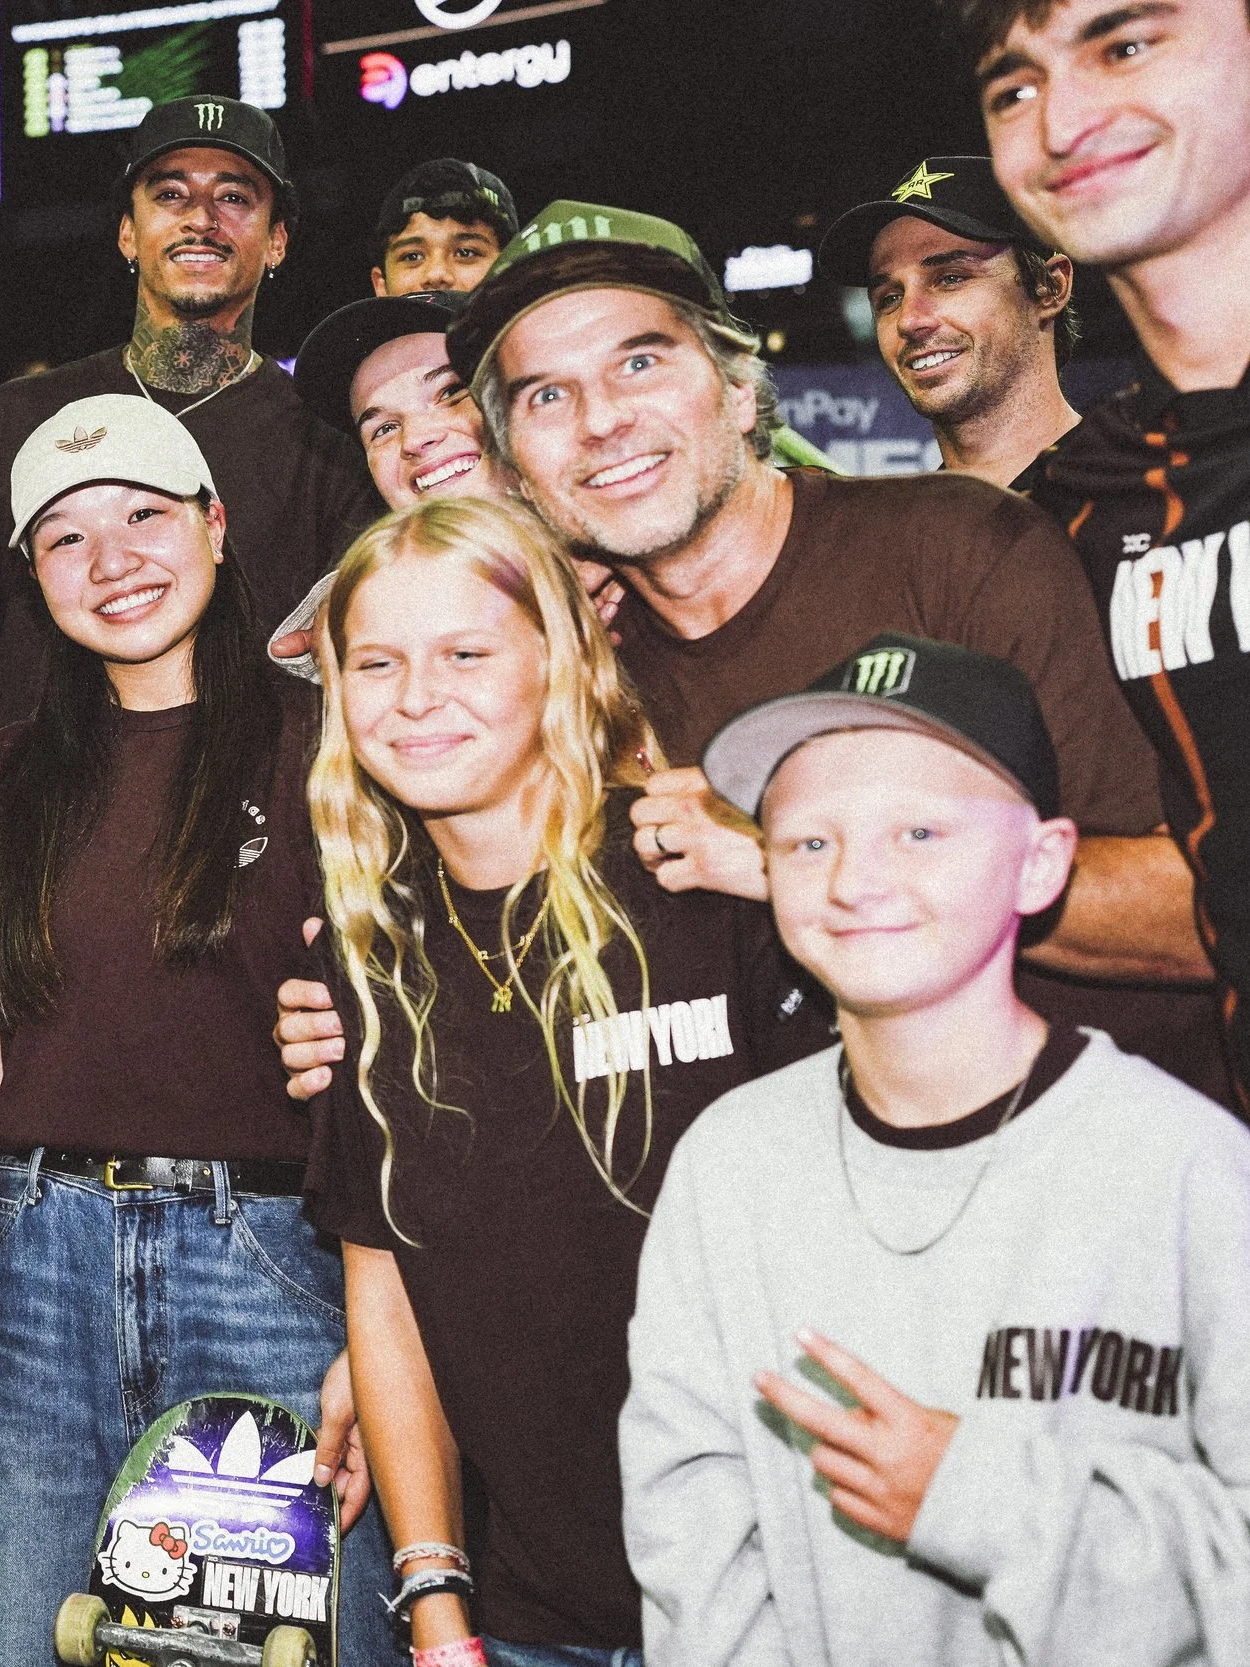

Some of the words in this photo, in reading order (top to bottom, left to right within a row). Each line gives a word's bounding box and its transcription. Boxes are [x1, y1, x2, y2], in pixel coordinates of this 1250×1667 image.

[774, 388, 881, 433] nPay
[1110, 531, 1226, 681] NEW
[977, 1326, 1071, 1401] NEW
[1069, 1326, 1183, 1417] YORK
[203, 1562, 261, 1612] NEW
[263, 1569, 330, 1622] YORK
